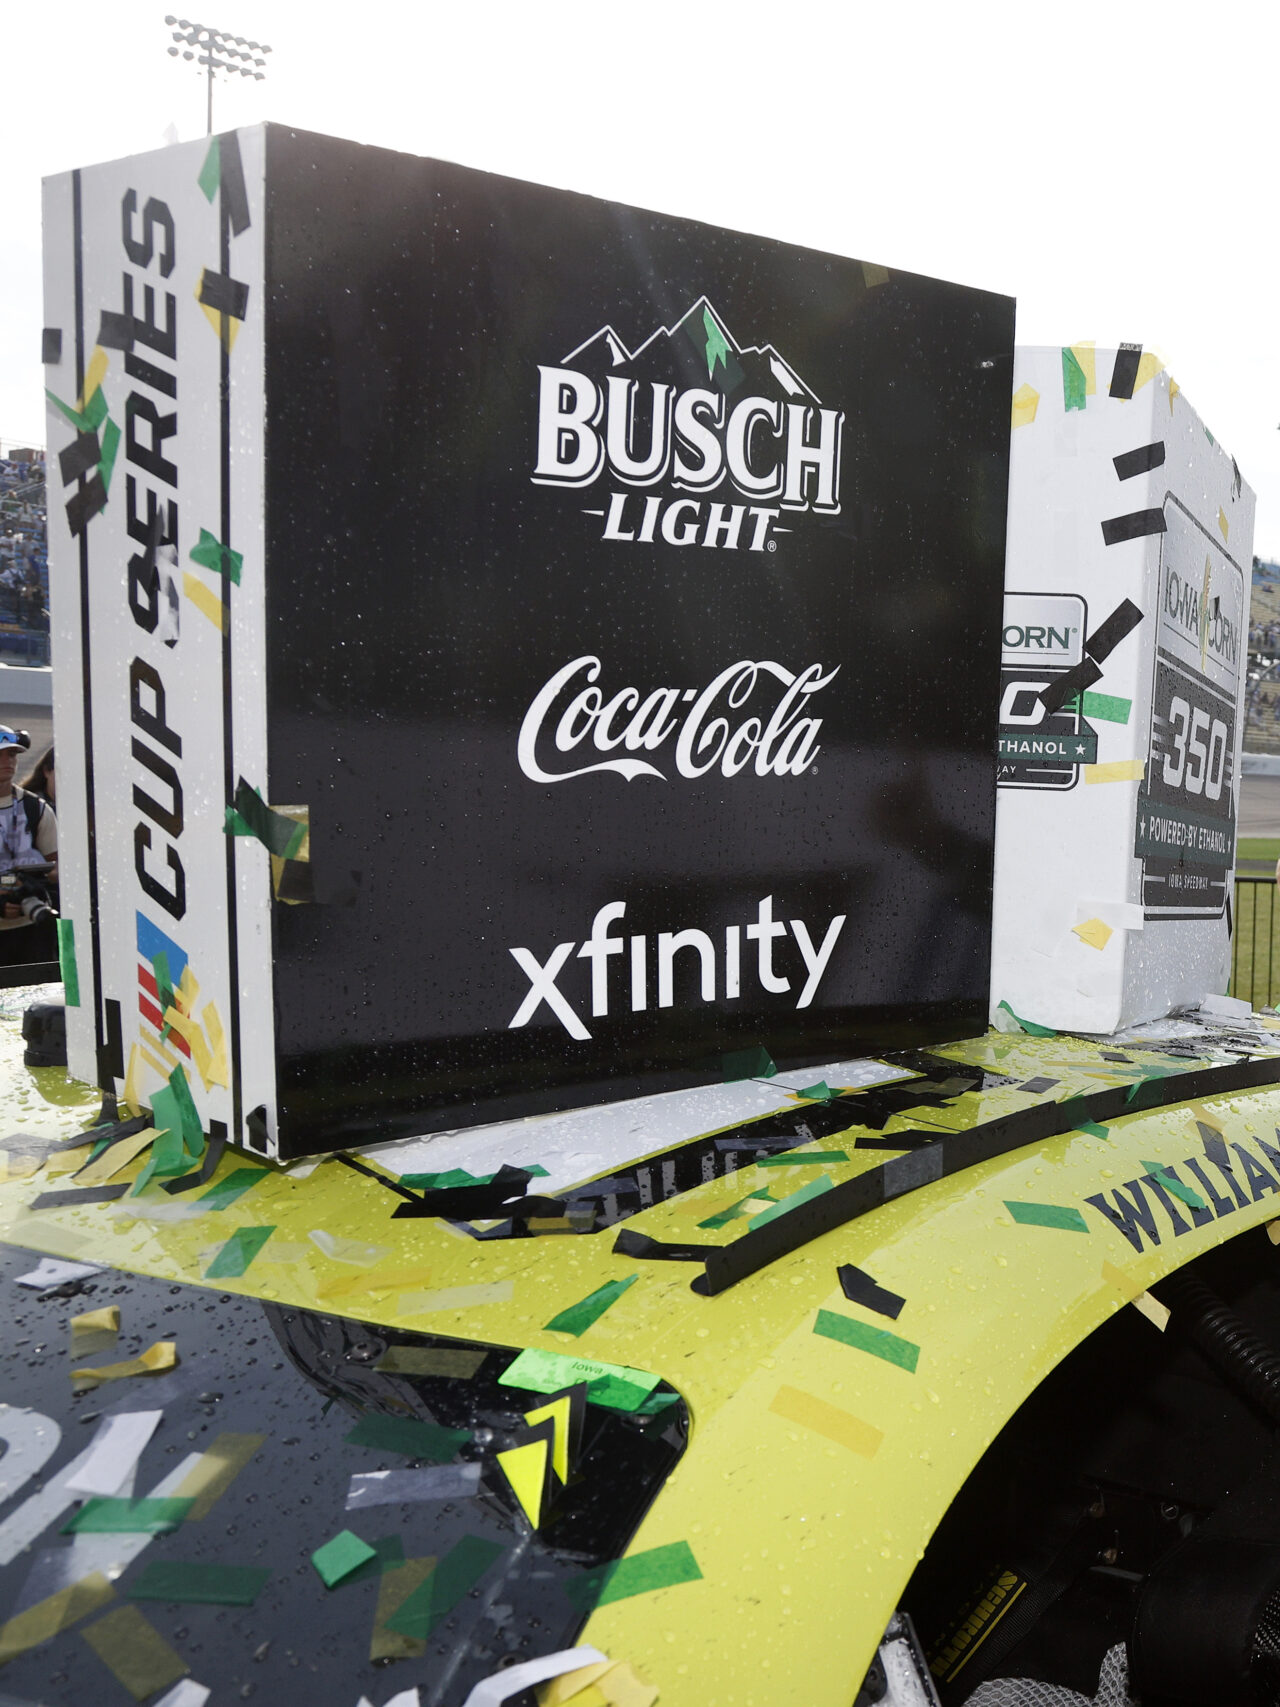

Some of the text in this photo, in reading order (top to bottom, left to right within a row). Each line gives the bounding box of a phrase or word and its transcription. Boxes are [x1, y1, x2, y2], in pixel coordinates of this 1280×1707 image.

[530, 365, 845, 515] BUSCH
[120, 187, 187, 922] CUP SERIES
[601, 492, 780, 552] LIGHT
[1164, 566, 1200, 636] IOWA
[518, 655, 842, 784] Coca-Cola
[1162, 696, 1228, 801] 350
[1149, 815, 1226, 854] POWERED BY ETHANOL
[508, 895, 847, 1041] xfinity
[571, 1361, 604, 1374] Iowa
